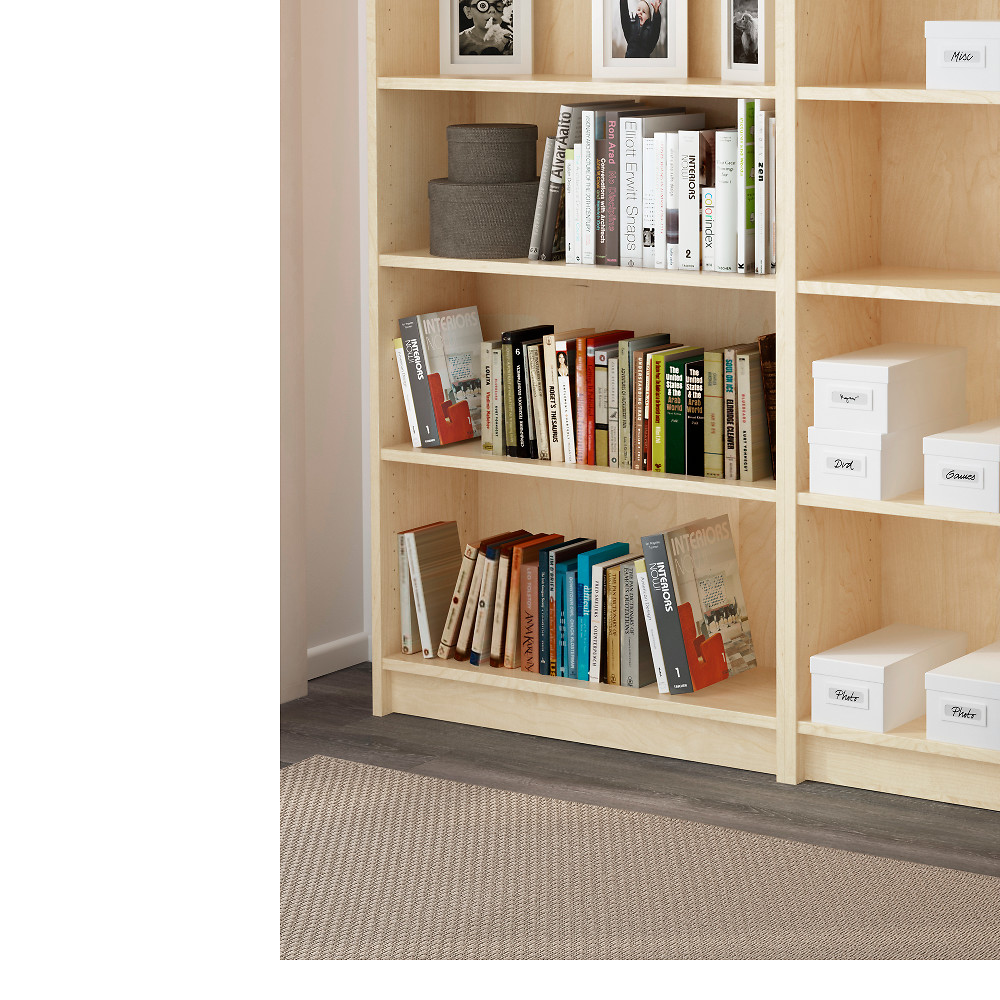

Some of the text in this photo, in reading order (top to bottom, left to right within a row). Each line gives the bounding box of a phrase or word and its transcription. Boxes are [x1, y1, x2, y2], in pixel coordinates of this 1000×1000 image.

[551, 111, 572, 179] Alvar Aalto
[623, 121, 639, 251] Elliott Erwitt Snaps
[688, 155, 696, 200] INTERIORS
[704, 192, 715, 249] colorindex
[411, 338, 424, 381] INTERIORS
[726, 399, 734, 426] ELDRIDGE
[726, 426, 735, 450] CLEAVER
[945, 469, 976, 481] Games
[583, 585, 591, 616] difficult
[657, 561, 673, 613] INTERIORS
